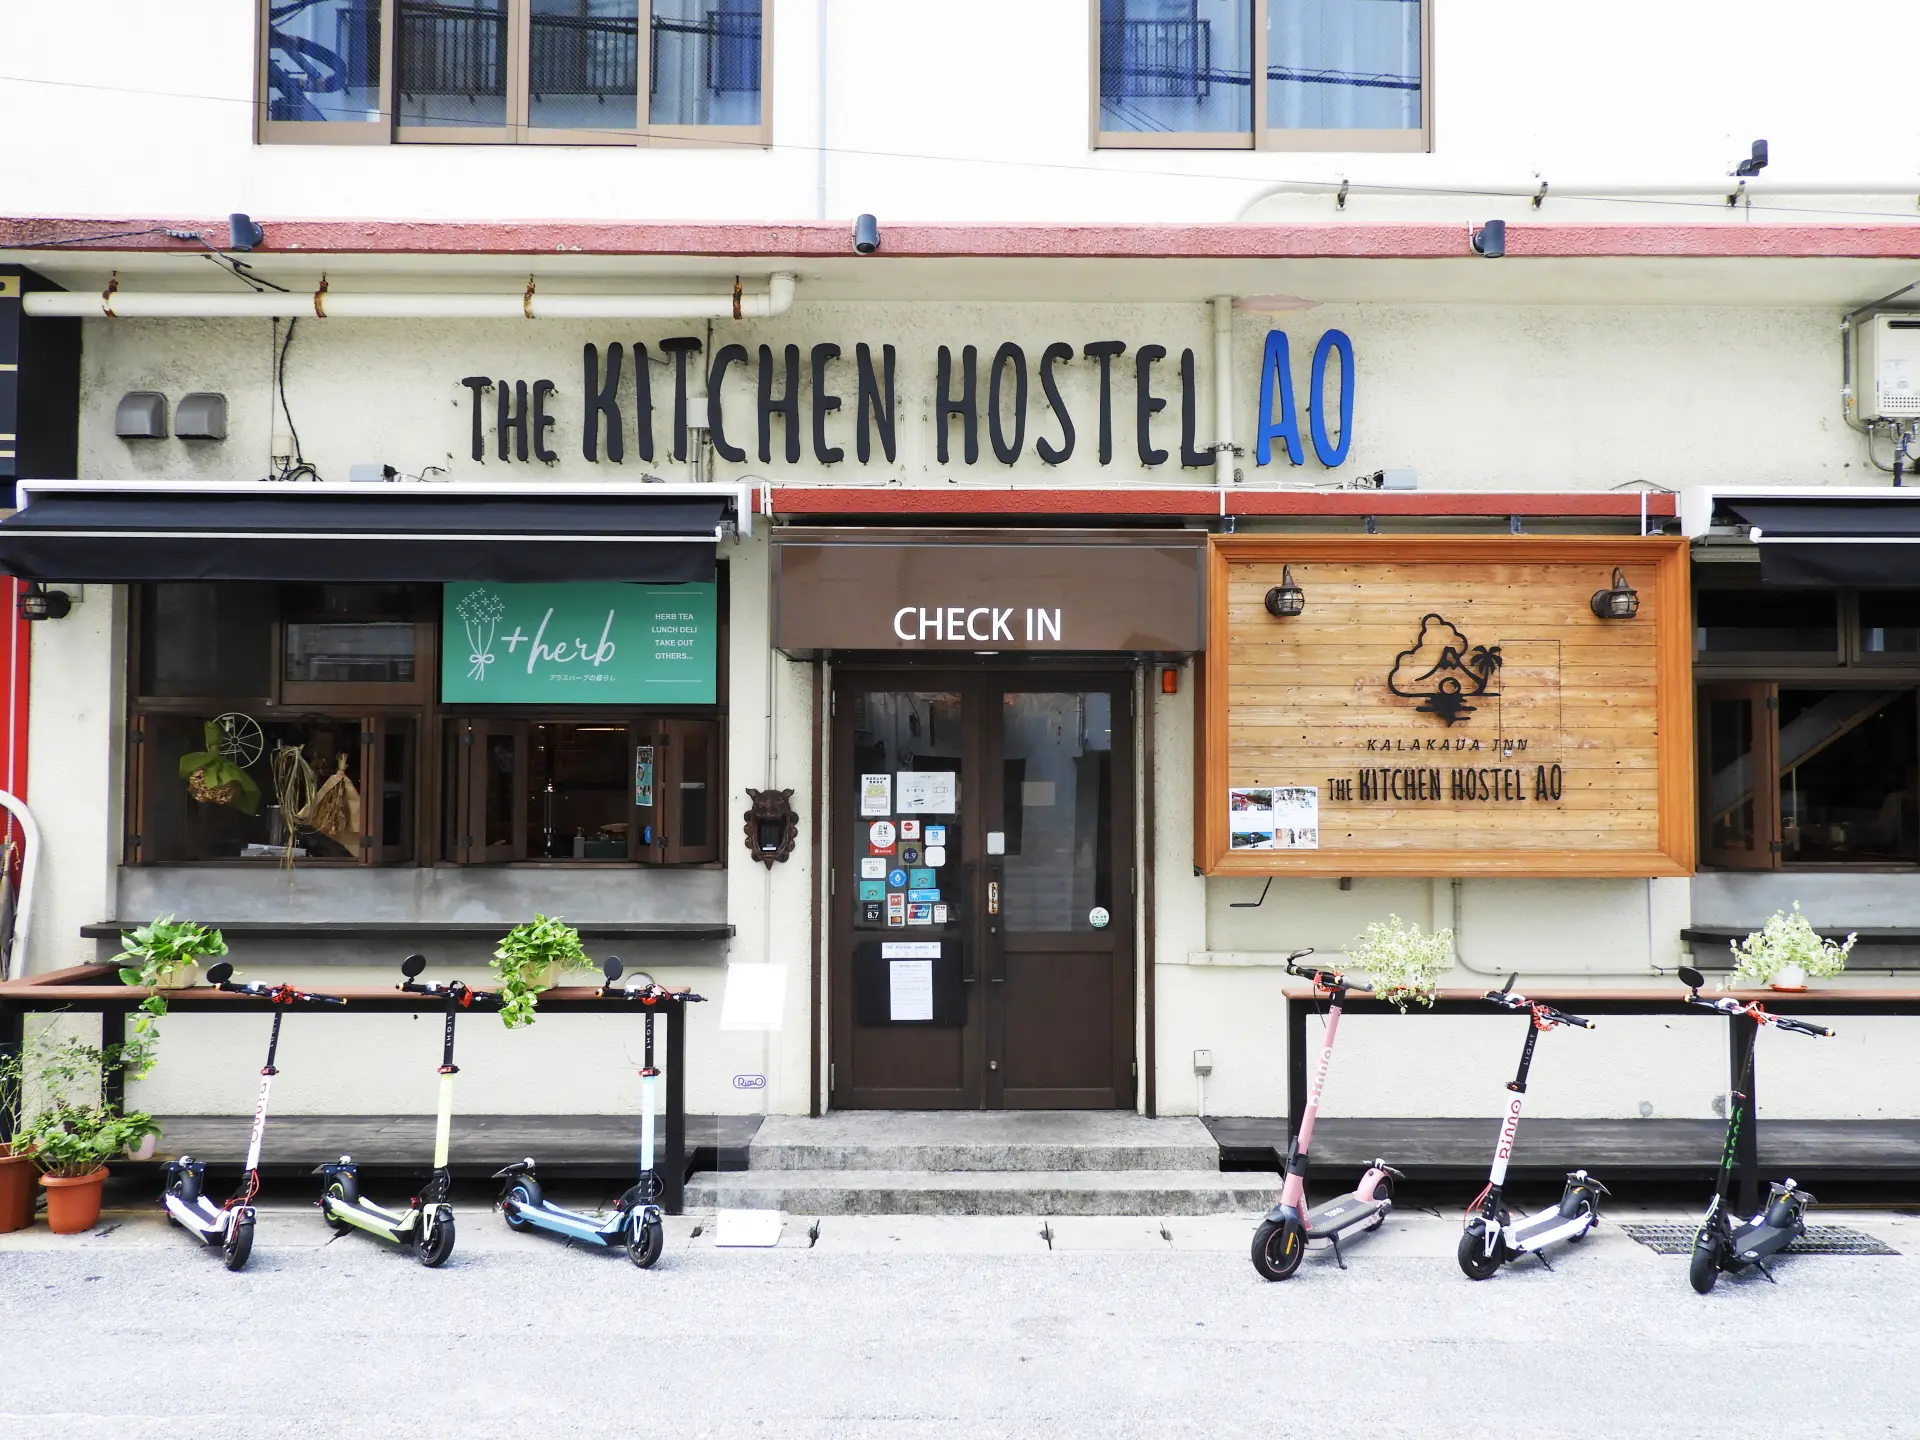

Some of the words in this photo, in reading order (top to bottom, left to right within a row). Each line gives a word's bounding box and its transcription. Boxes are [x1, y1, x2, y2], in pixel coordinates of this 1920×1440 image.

[461, 376, 556, 462] THE
[583, 337, 897, 464] KITCHEN
[936, 340, 1216, 467] HOSTEL
[1256, 328, 1355, 467] AO
[894, 607, 1014, 641] CHECK
[1026, 608, 1061, 641] IN
[655, 639, 676, 647] TAKE
[677, 639, 694, 647] OUT
[655, 652, 693, 660] OTHERS...
[1367, 738, 1481, 751] KALAKAUA
[1491, 738, 1529, 751] INN
[1327, 778, 1354, 801] THE
[1358, 768, 1442, 801] KITCHEN
[1450, 767, 1527, 802] HOSTEL
[1535, 763, 1562, 801] AO
[867, 911, 879, 919] 8.7
[1523, 1033, 1536, 1066] LIGHT
